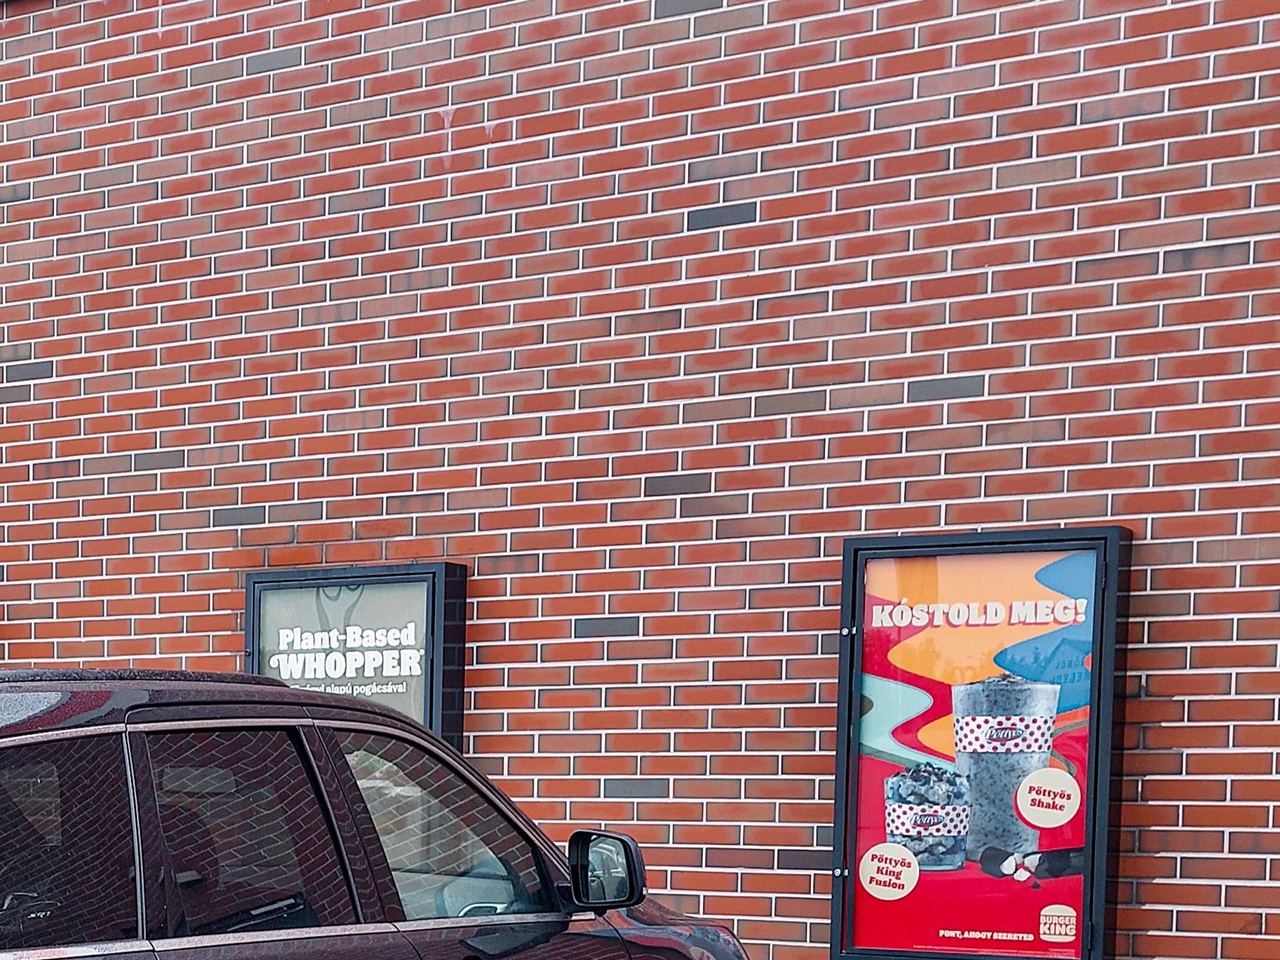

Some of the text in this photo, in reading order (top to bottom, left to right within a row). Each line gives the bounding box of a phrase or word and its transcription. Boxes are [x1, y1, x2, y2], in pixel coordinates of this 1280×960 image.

[871, 597, 1088, 627] KÓSTOLD MEG!
[278, 622, 416, 650] Plant-Based
[269, 649, 422, 680] WHOPPER
[352, 681, 407, 697] pogácsával
[1027, 785, 1072, 800] Pöttyös
[1029, 798, 1065, 811] Shake
[870, 853, 912, 869] Pöttyös
[876, 866, 903, 880] King
[868, 876, 905, 891] Fusion
[1040, 916, 1077, 925] BURGER
[1039, 924, 1077, 936] KING
